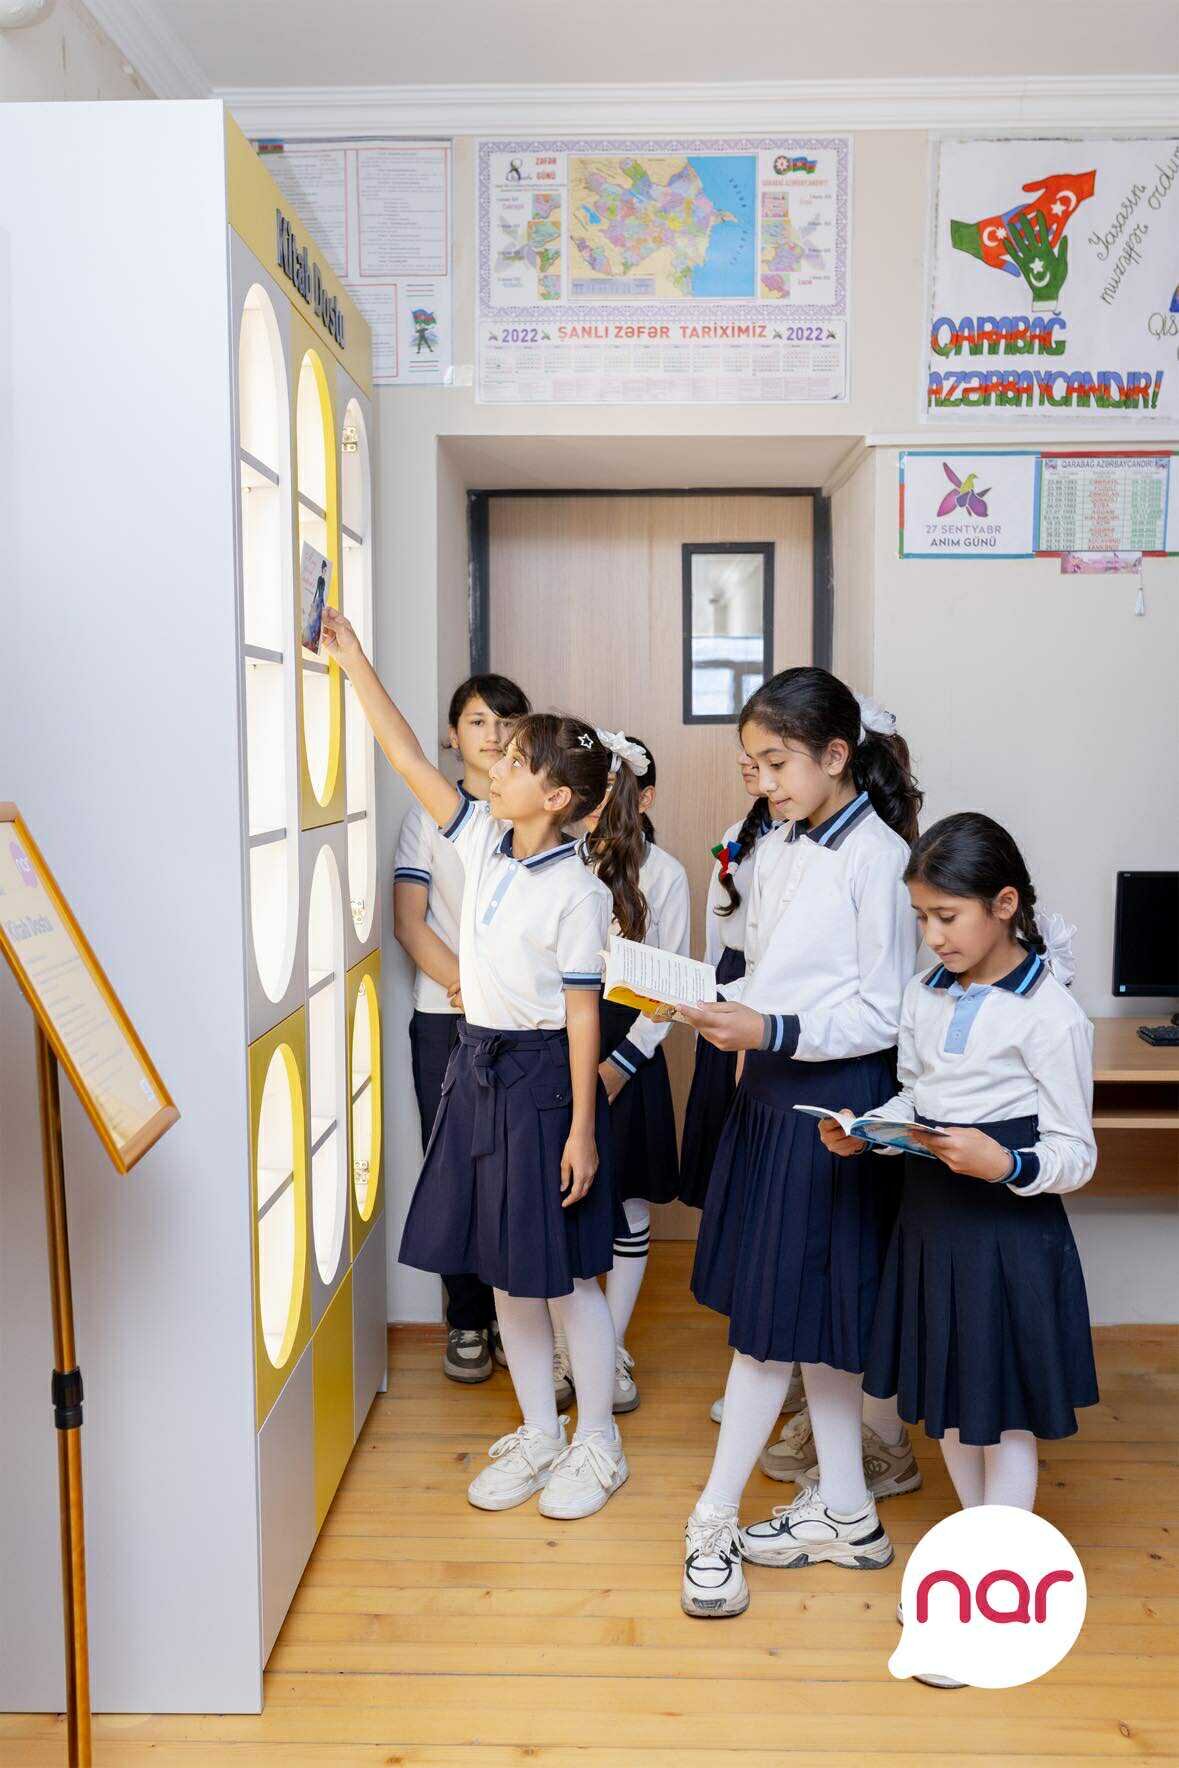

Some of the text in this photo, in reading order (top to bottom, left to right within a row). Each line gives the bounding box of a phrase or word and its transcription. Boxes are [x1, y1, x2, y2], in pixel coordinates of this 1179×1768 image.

[276, 207, 311, 305] Kitab
[313, 262, 345, 350] Dostu
[501, 328, 539, 343] 2022
[613, 325, 671, 340] ZƏFƏR
[679, 321, 768, 339] TARİXİMİZ
[786, 326, 824, 341] 2022
[930, 311, 1067, 358] QARABAĞ
[928, 369, 1165, 410] AZƏRBAYCANDIR!
[925, 524, 1002, 535] 27 SENTYABR
[930, 535, 998, 548] ANIM GÜNÜ
